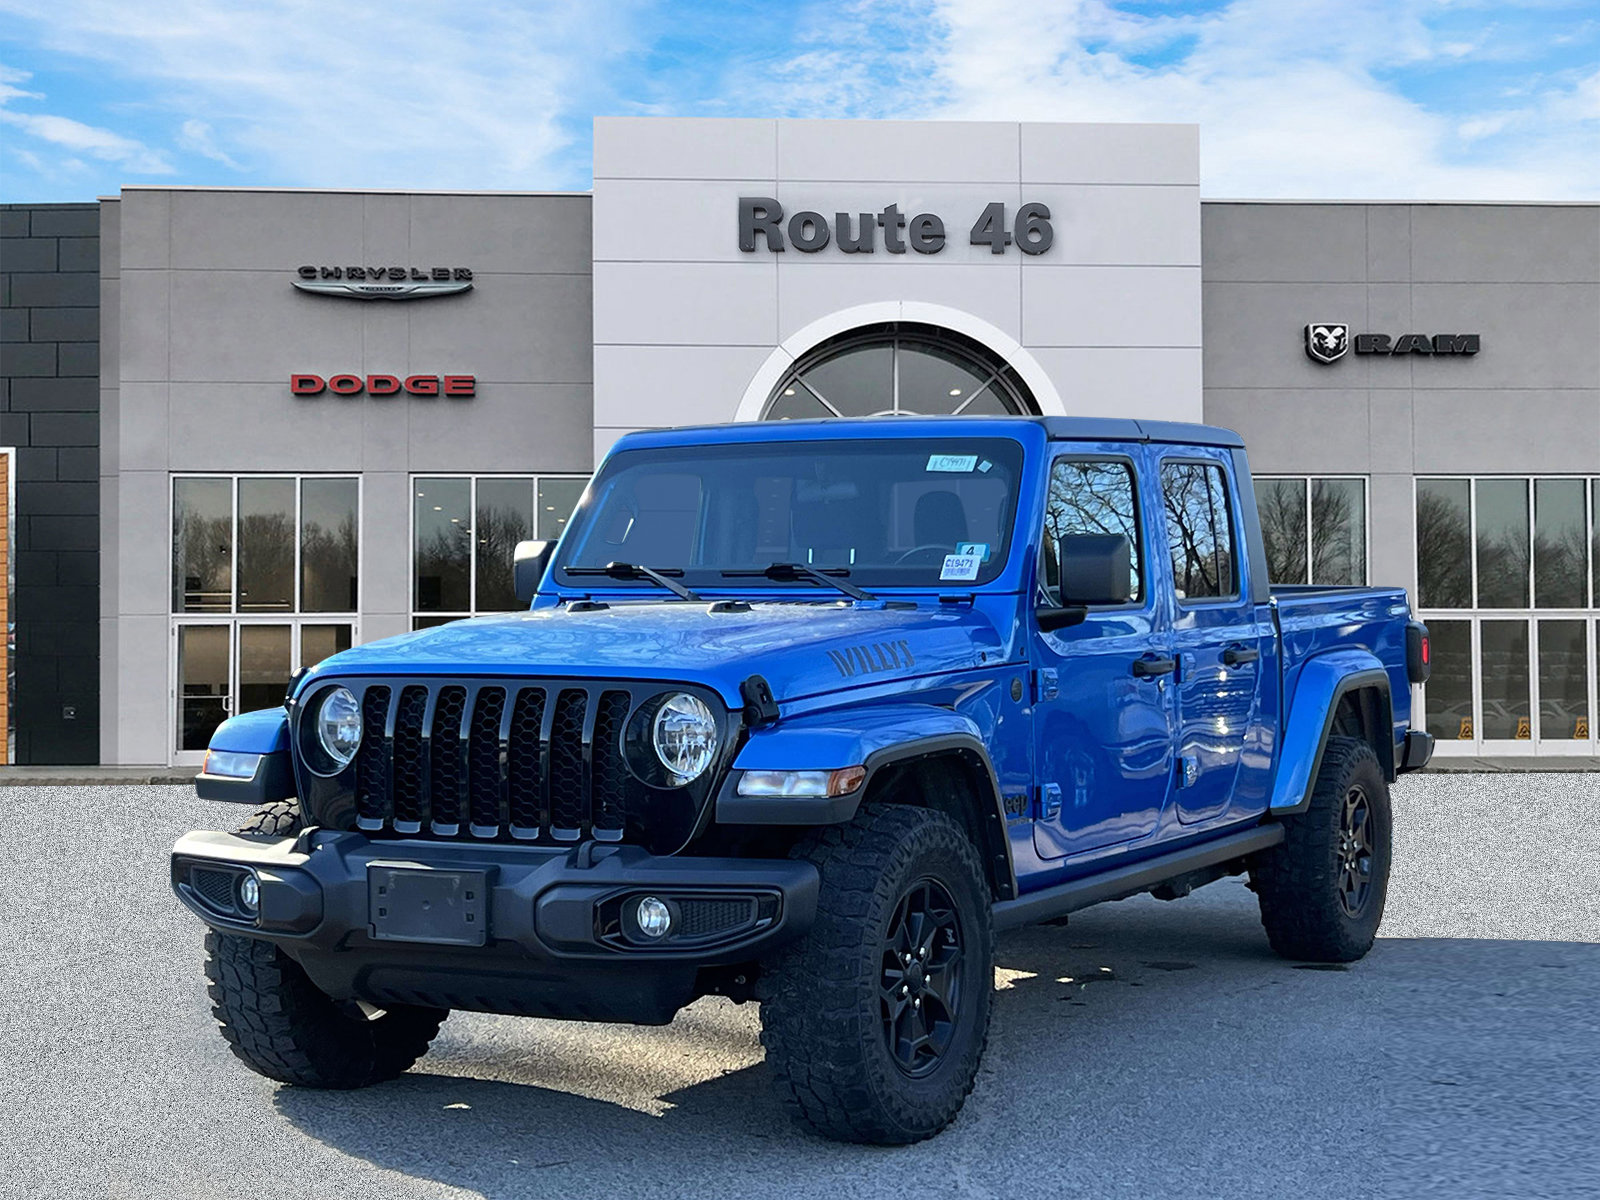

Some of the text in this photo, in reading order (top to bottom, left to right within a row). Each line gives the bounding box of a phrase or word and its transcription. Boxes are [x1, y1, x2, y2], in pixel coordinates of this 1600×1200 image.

[739, 197, 1054, 255] Route 46
[298, 266, 473, 280] CHRYSLER
[1354, 334, 1480, 355] RAM
[291, 374, 476, 397] DODGE
[825, 640, 915, 677] WILLYS
